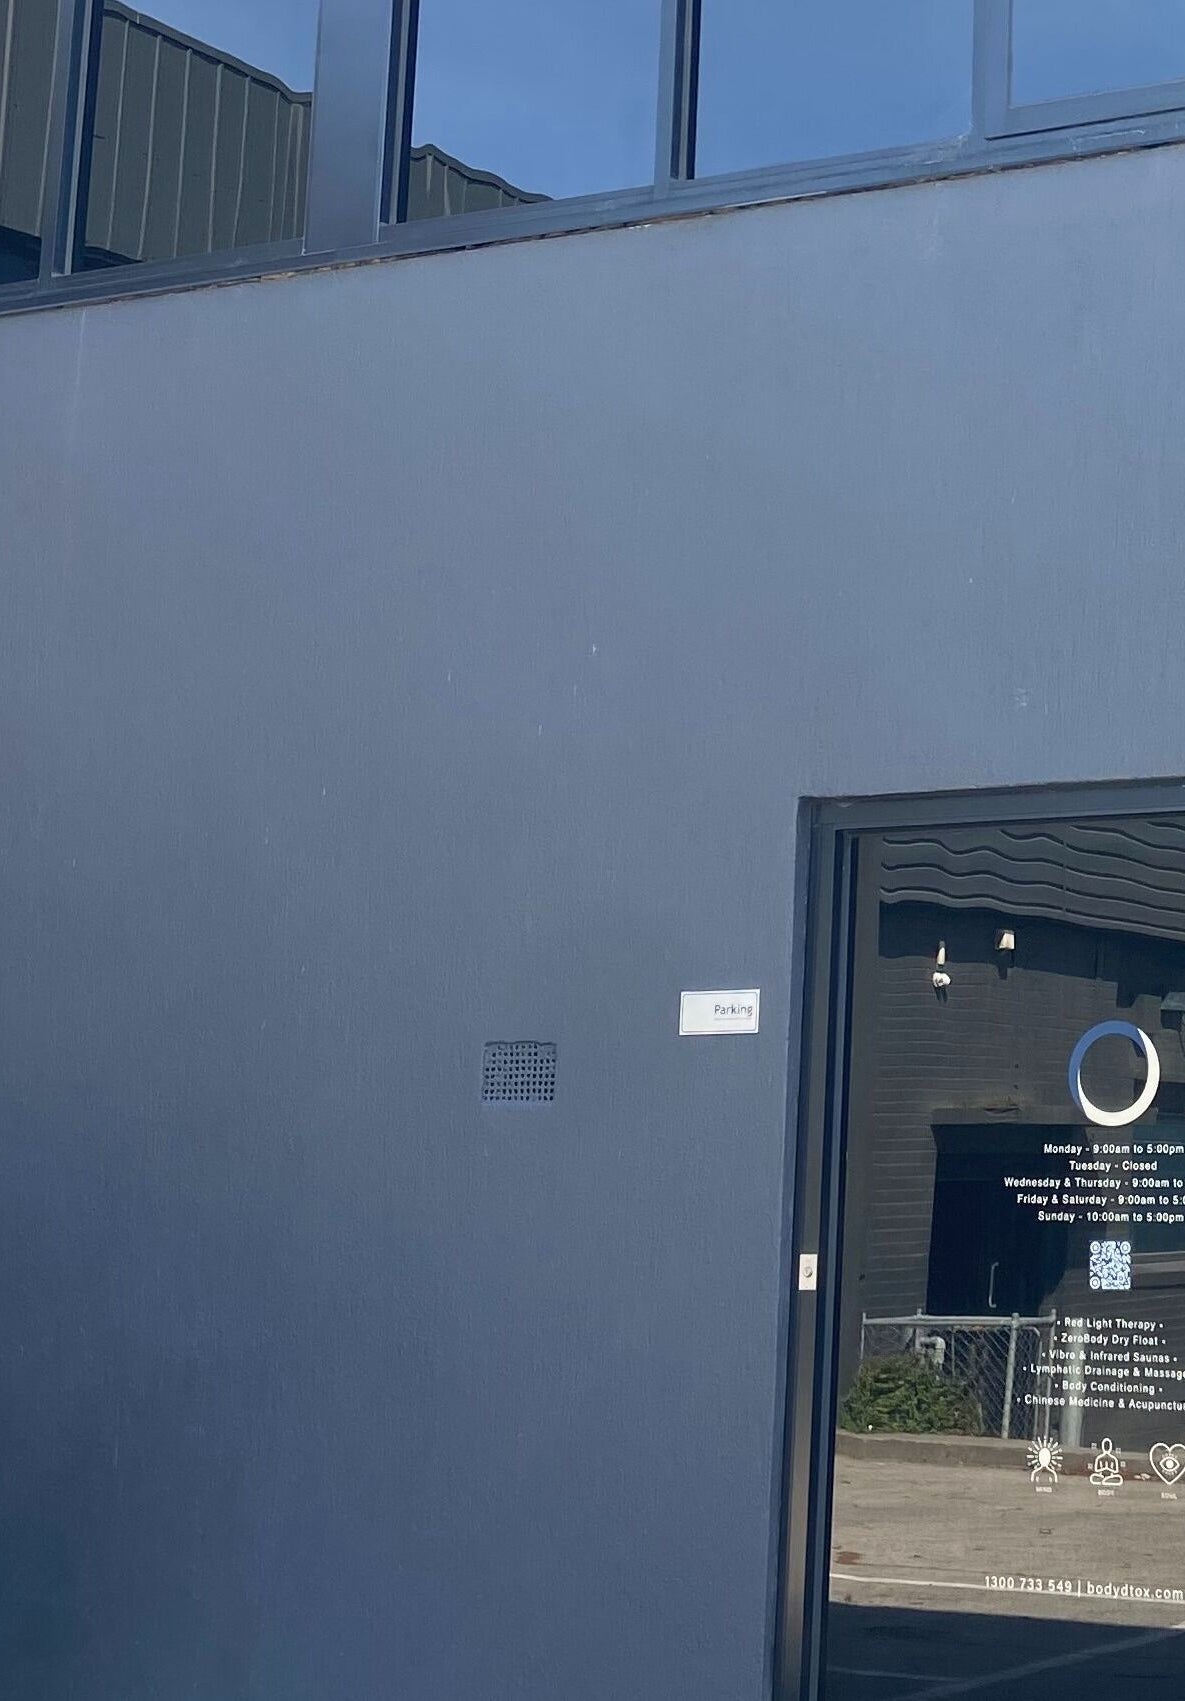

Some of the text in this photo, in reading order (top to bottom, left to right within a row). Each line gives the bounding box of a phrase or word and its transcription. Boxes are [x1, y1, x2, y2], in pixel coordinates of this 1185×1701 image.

[714, 1004, 753, 1016] Parking
[1044, 1144, 1082, 1155] Monday
[1093, 1145, 1130, 1154] 9:00am
[1133, 1145, 1143, 1154] to
[1146, 1145, 1184, 1155] 5:00pm
[1069, 1160, 1111, 1171] Tuesday
[1122, 1161, 1157, 1170] Closed
[1004, 1177, 1061, 1188] Wednesday
[1064, 1178, 1071, 1187] &
[1075, 1178, 1121, 1189] Thursday
[1132, 1178, 1169, 1187] 9:00am
[1173, 1179, 1183, 1187] to
[1017, 1194, 1048, 1205] Friday
[1052, 1195, 1058, 1204] &
[1062, 1195, 1107, 1206] Saturday
[1118, 1195, 1155, 1204] 9:00am
[1159, 1196, 1169, 1205] to
[1038, 1211, 1075, 1222] Sunday
[1087, 1212, 1129, 1221] 10:00am
[1133, 1213, 1143, 1221] to
[1146, 1213, 1184, 1223] 5:00pm
[1064, 1318, 1156, 1331] Red Light Therapy
[1061, 1333, 1158, 1346] ZeroBody Dry Float
[1050, 1351, 1170, 1363] Vibro & Infrared Saunas
[1030, 1364, 1081, 1377] Lymphatic
[1085, 1366, 1129, 1377] Drainage
[1133, 1367, 1140, 1376] &
[1062, 1381, 1154, 1395] Body Conditioning
[1025, 1394, 1065, 1406] Chinese
[1069, 1397, 1114, 1408] Medicine
[1119, 1398, 1125, 1408] &
[984, 1576, 1014, 1589] 1300
[1020, 1578, 1042, 1591] 733
[1049, 1580, 1072, 1592] 549
[1087, 1581, 1183, 1600] bodydtox.com
